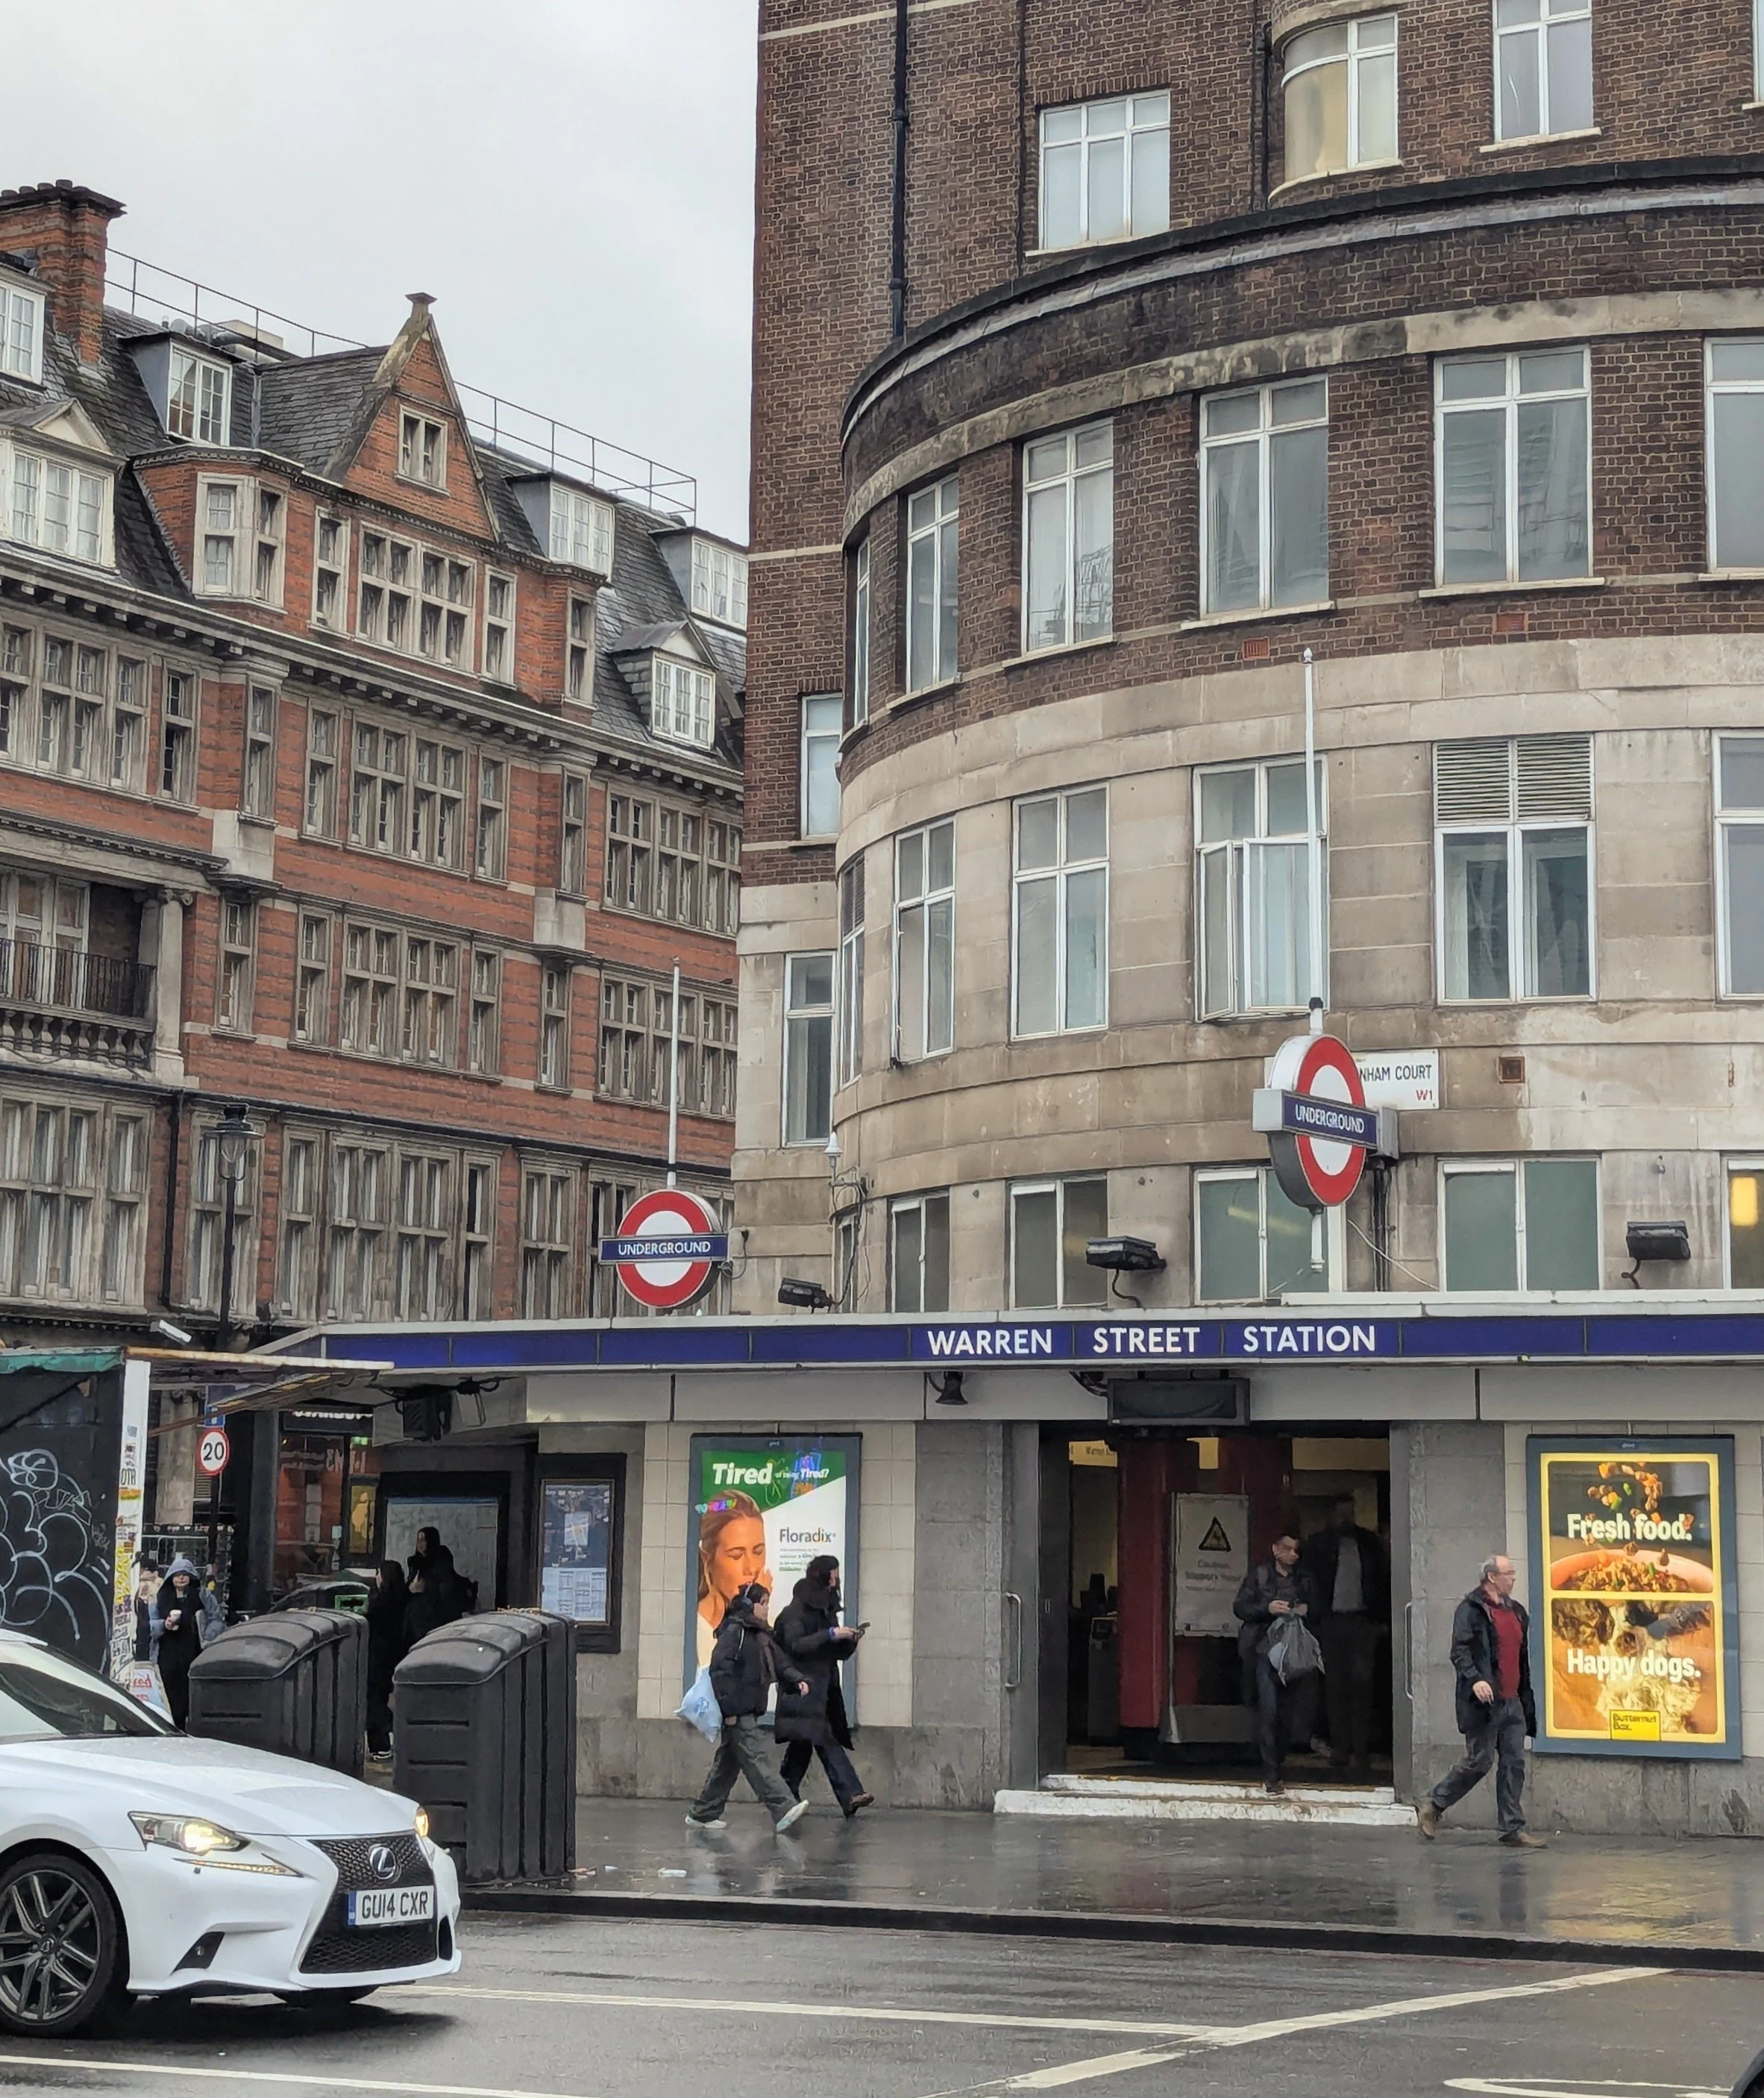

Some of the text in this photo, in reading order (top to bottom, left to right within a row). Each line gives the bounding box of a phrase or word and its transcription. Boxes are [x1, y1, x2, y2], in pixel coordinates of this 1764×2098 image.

[1359, 1064, 1432, 1081] NHAM COURT
[1415, 1089, 1432, 1100] W1
[1295, 1103, 1364, 1133] UNDERGROUND
[618, 1241, 711, 1256] UNDERGROUND
[927, 1325, 1375, 1356] WARREN STREET STATION
[203, 1441, 225, 1461] 20
[712, 1462, 773, 1485] Tired
[779, 1526, 832, 1543] Floradix
[1567, 1512, 1692, 1541] Fresh food.
[1567, 1648, 1701, 1683] Happy dogs.
[362, 1891, 428, 1919] GU14 CXR
